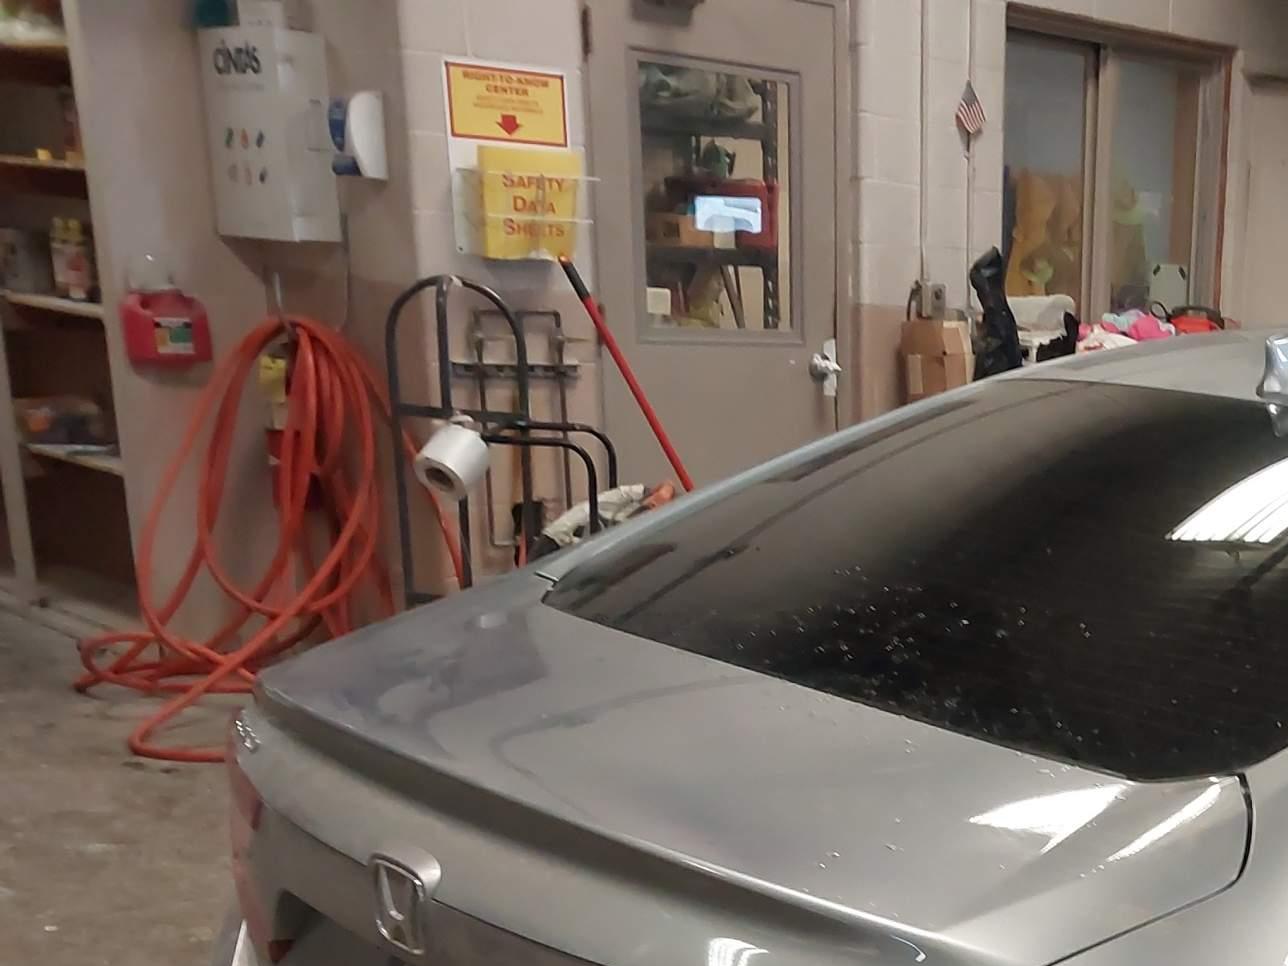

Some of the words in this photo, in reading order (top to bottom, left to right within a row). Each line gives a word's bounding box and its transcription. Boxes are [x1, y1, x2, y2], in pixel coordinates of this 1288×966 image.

[461, 69, 550, 89] RIGHT-TO-KNOW
[485, 83, 529, 97] CENTER
[501, 172, 566, 193] SAFETY
[512, 195, 557, 215] DAA
[502, 217, 566, 239] SHETS
